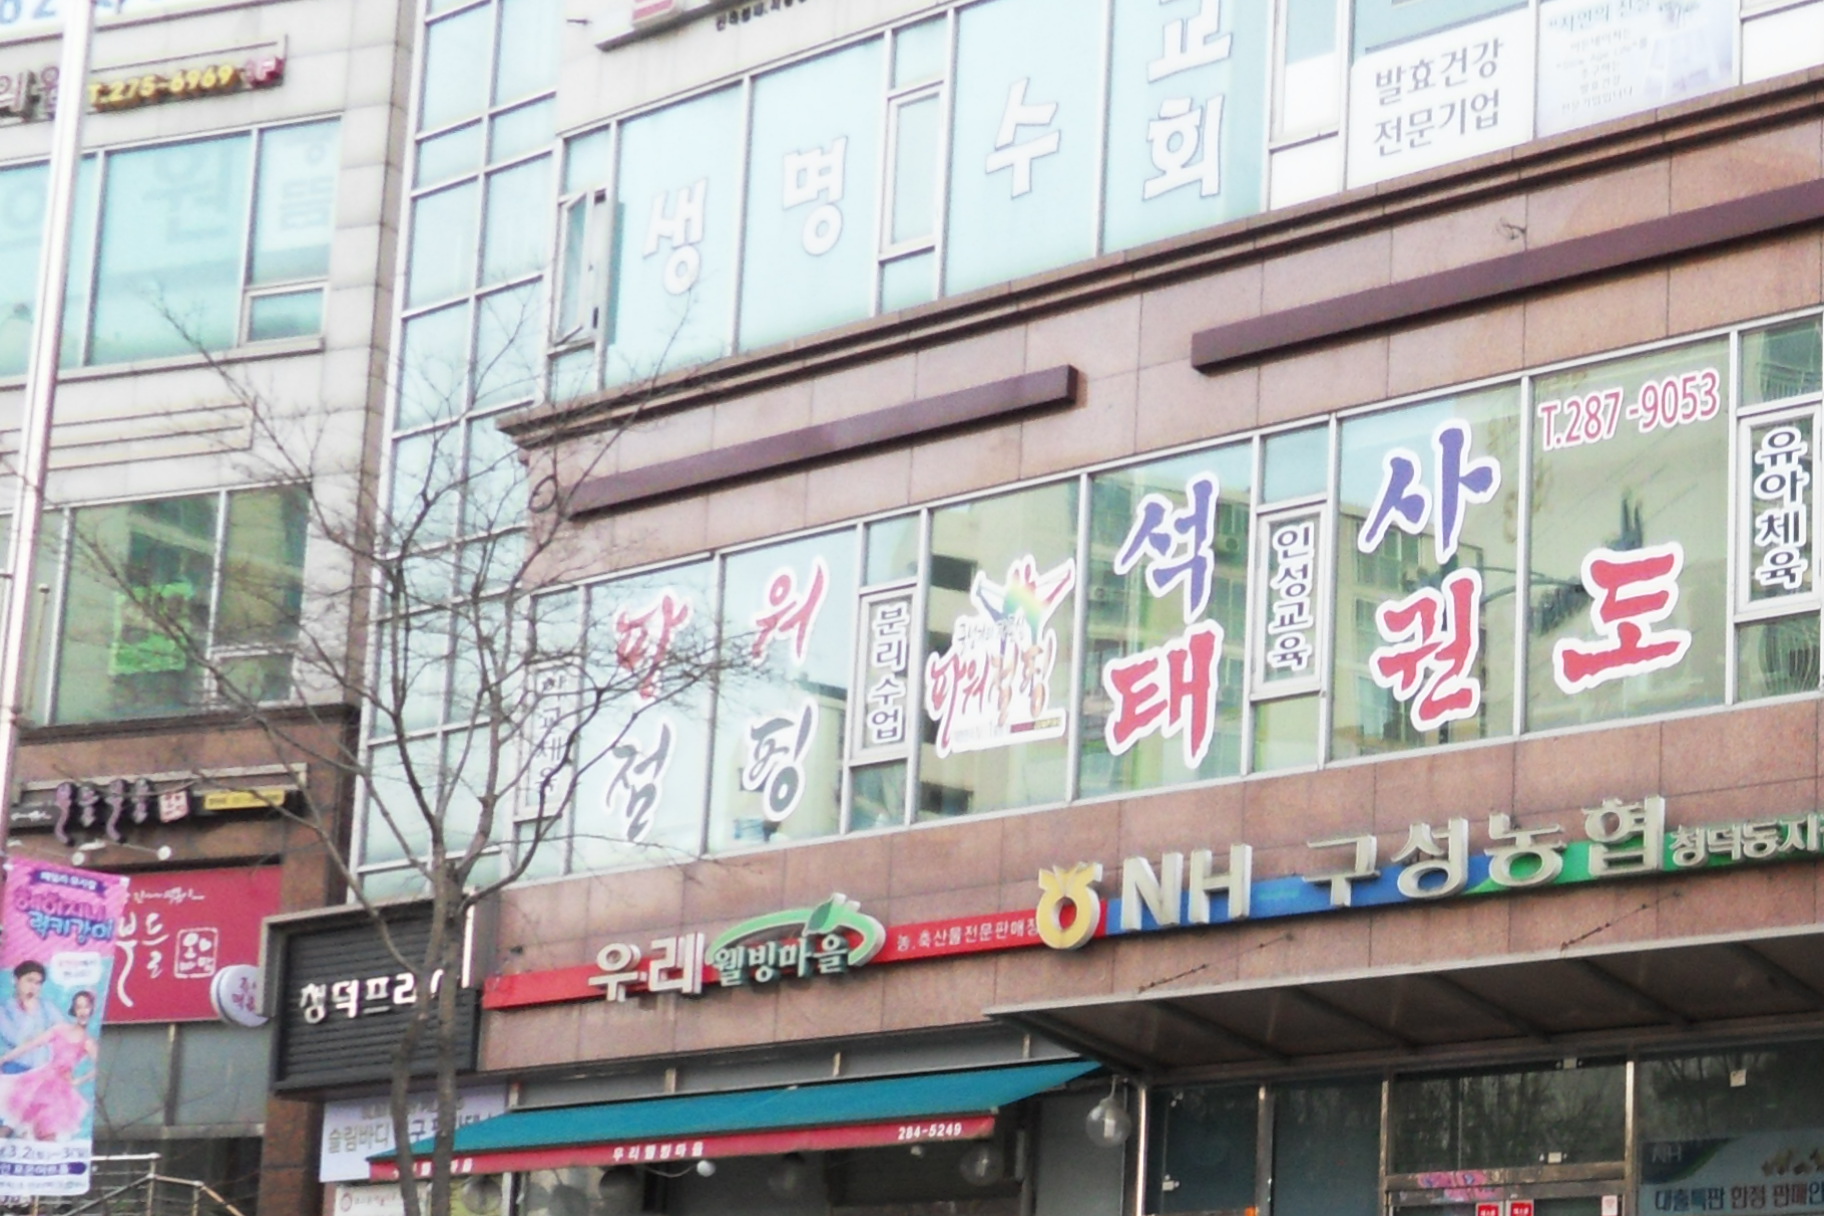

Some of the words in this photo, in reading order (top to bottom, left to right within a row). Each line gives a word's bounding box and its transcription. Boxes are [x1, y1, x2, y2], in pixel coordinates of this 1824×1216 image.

[1374, 37, 1504, 102] 발효건강
[1373, 89, 1502, 157] 전문기업
[1754, 425, 1807, 589] 유아체육
[1266, 522, 1317, 671] 인성교육
[867, 600, 912, 746] 분리수업
[1121, 843, 1252, 932] NH
[1302, 795, 1666, 907] 구성농협
[587, 932, 706, 1002] 우리
[711, 934, 849, 987] 웰빙마을
[898, 1121, 962, 1141] 284-5249
